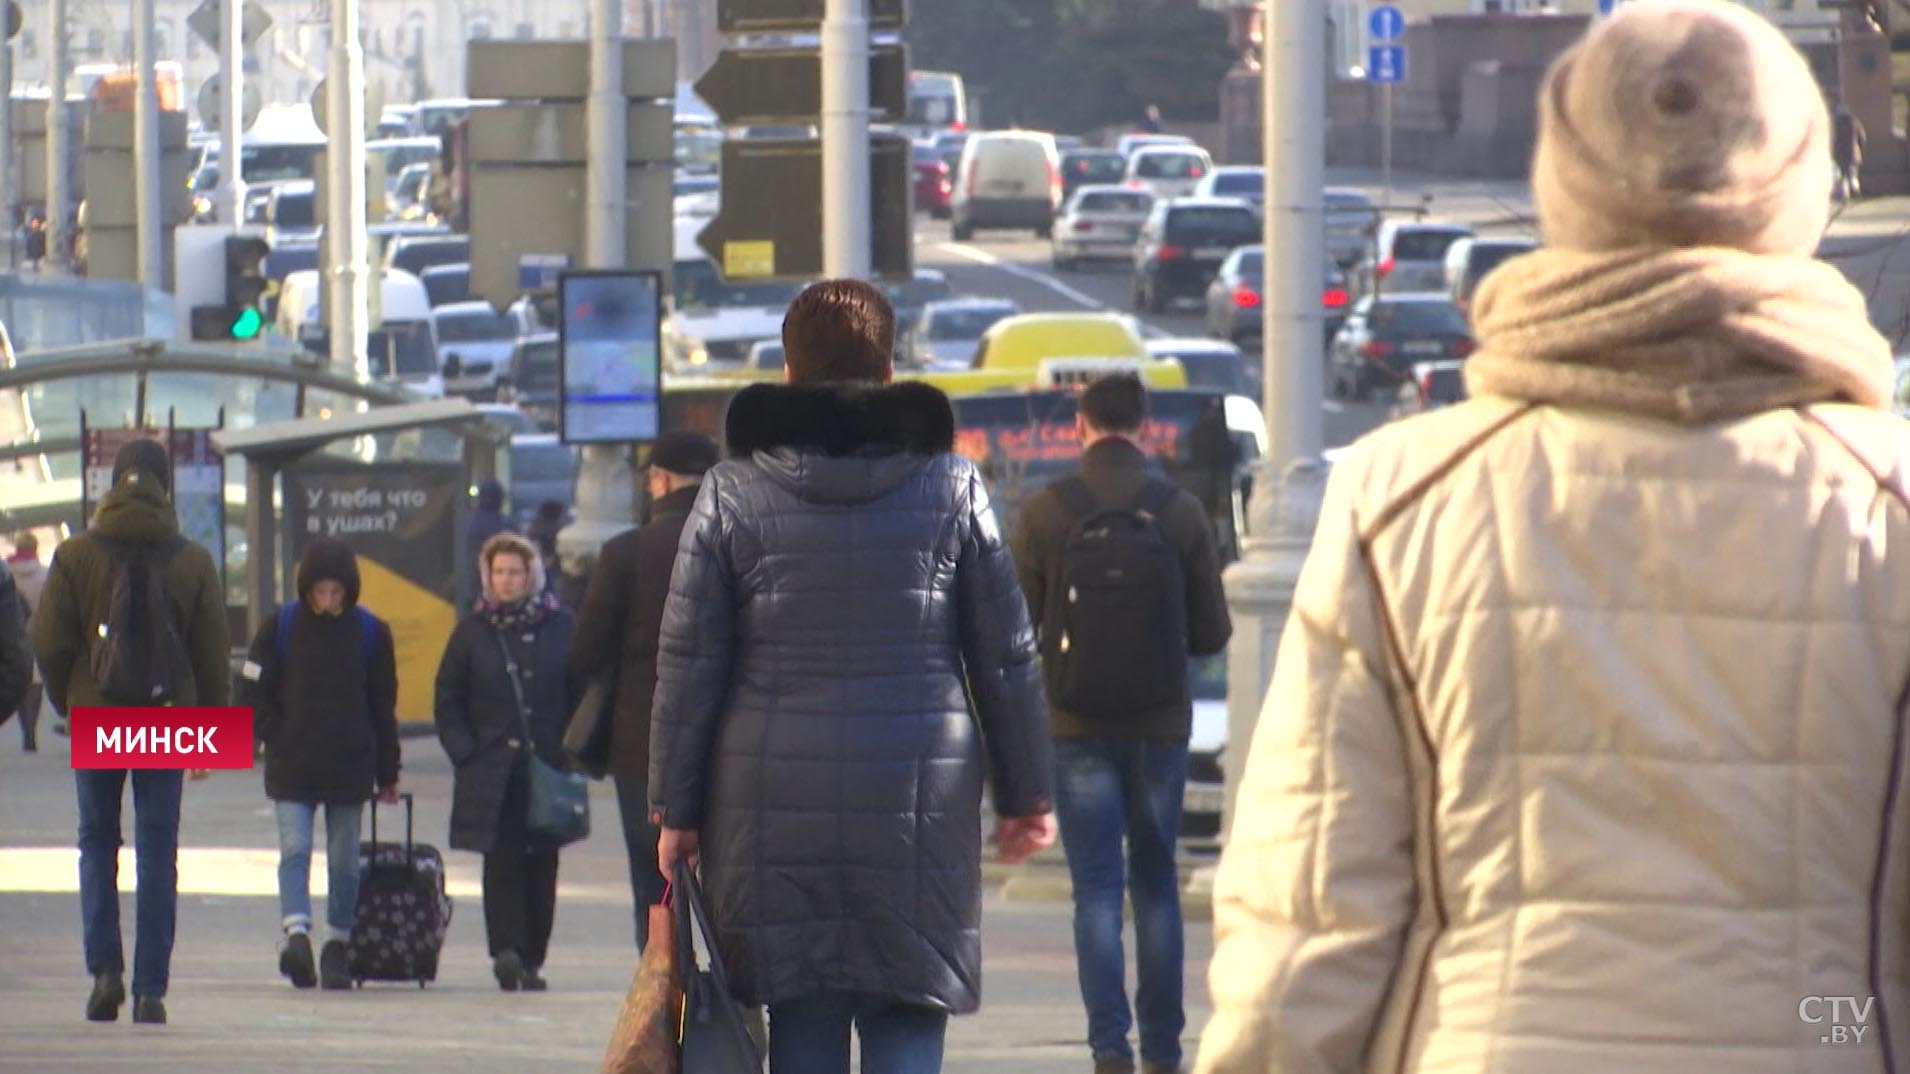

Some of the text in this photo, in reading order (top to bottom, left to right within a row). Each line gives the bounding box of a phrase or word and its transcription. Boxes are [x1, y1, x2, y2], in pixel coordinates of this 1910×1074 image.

[307, 486, 427, 509] У тебя что
[306, 509, 398, 537] в ушах?
